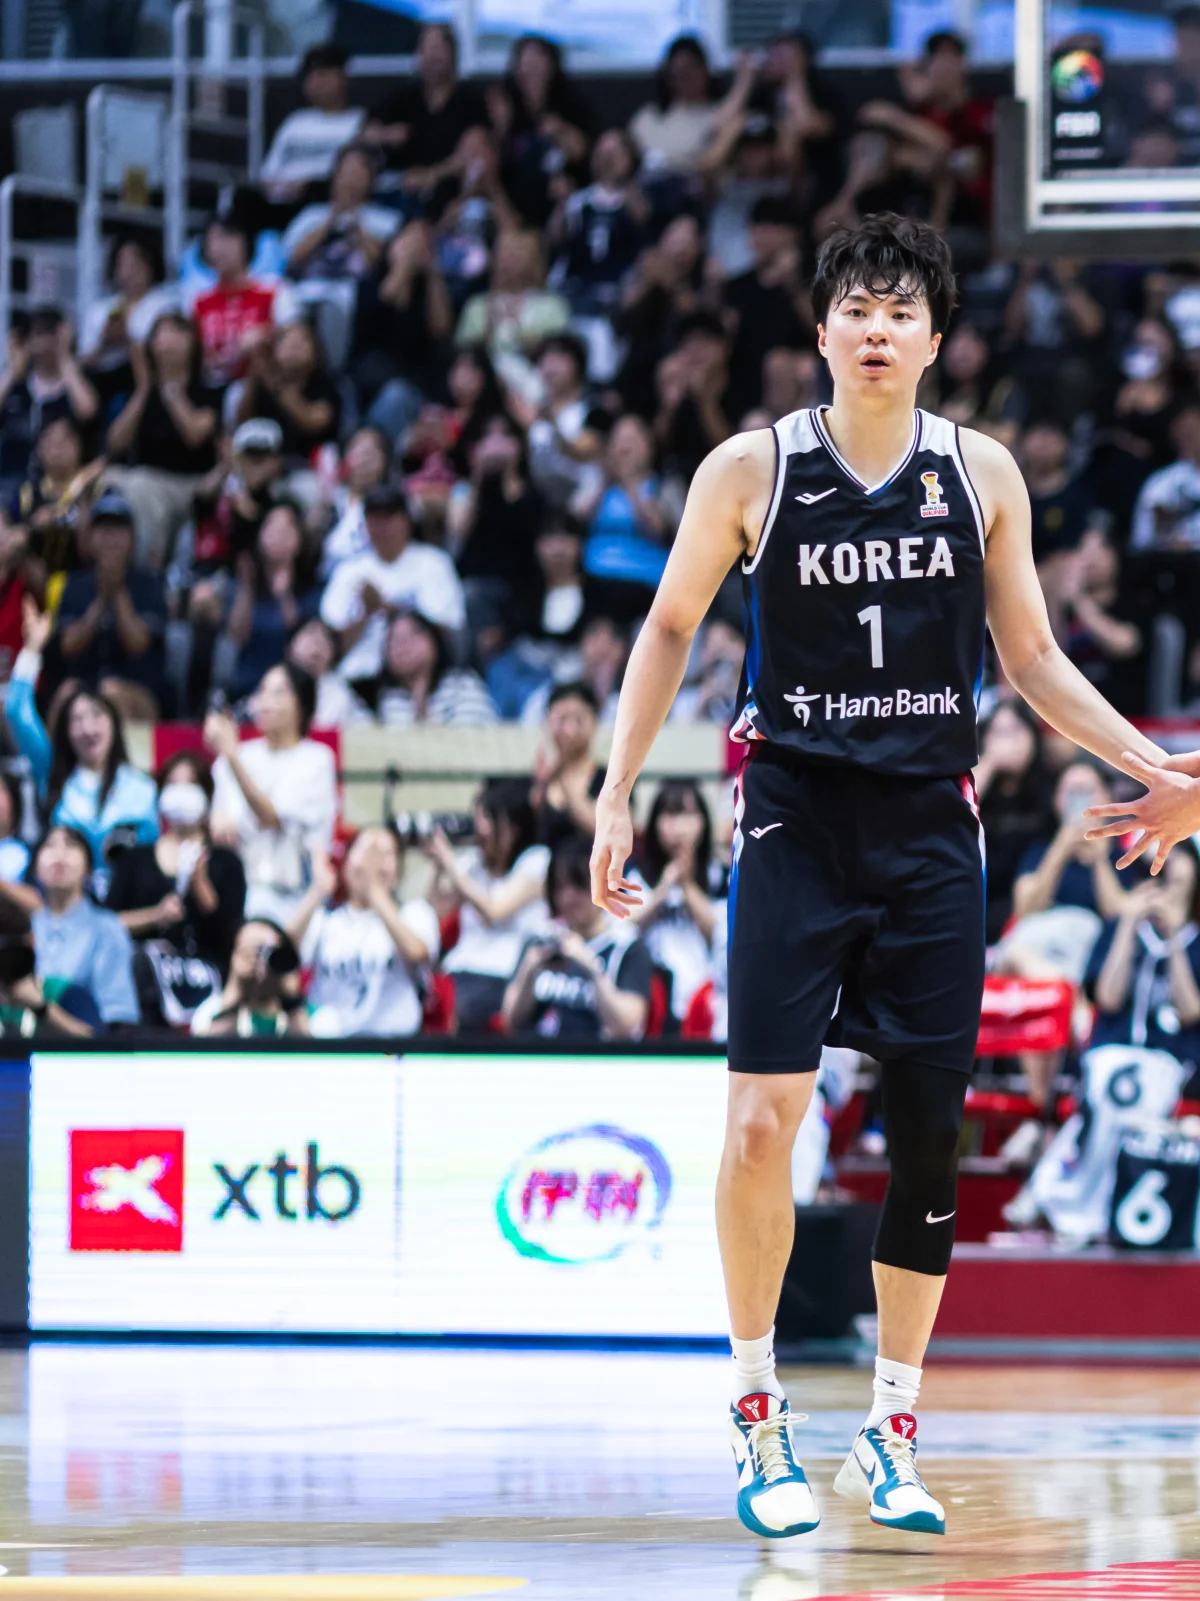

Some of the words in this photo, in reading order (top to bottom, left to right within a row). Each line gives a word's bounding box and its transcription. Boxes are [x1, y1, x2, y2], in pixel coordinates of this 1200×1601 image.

[797, 536, 955, 586] KOREA
[857, 604, 884, 669] 1
[825, 686, 961, 721] HanaBank
[212, 1141, 361, 1222] xtb
[1115, 1168, 1173, 1246] 6
